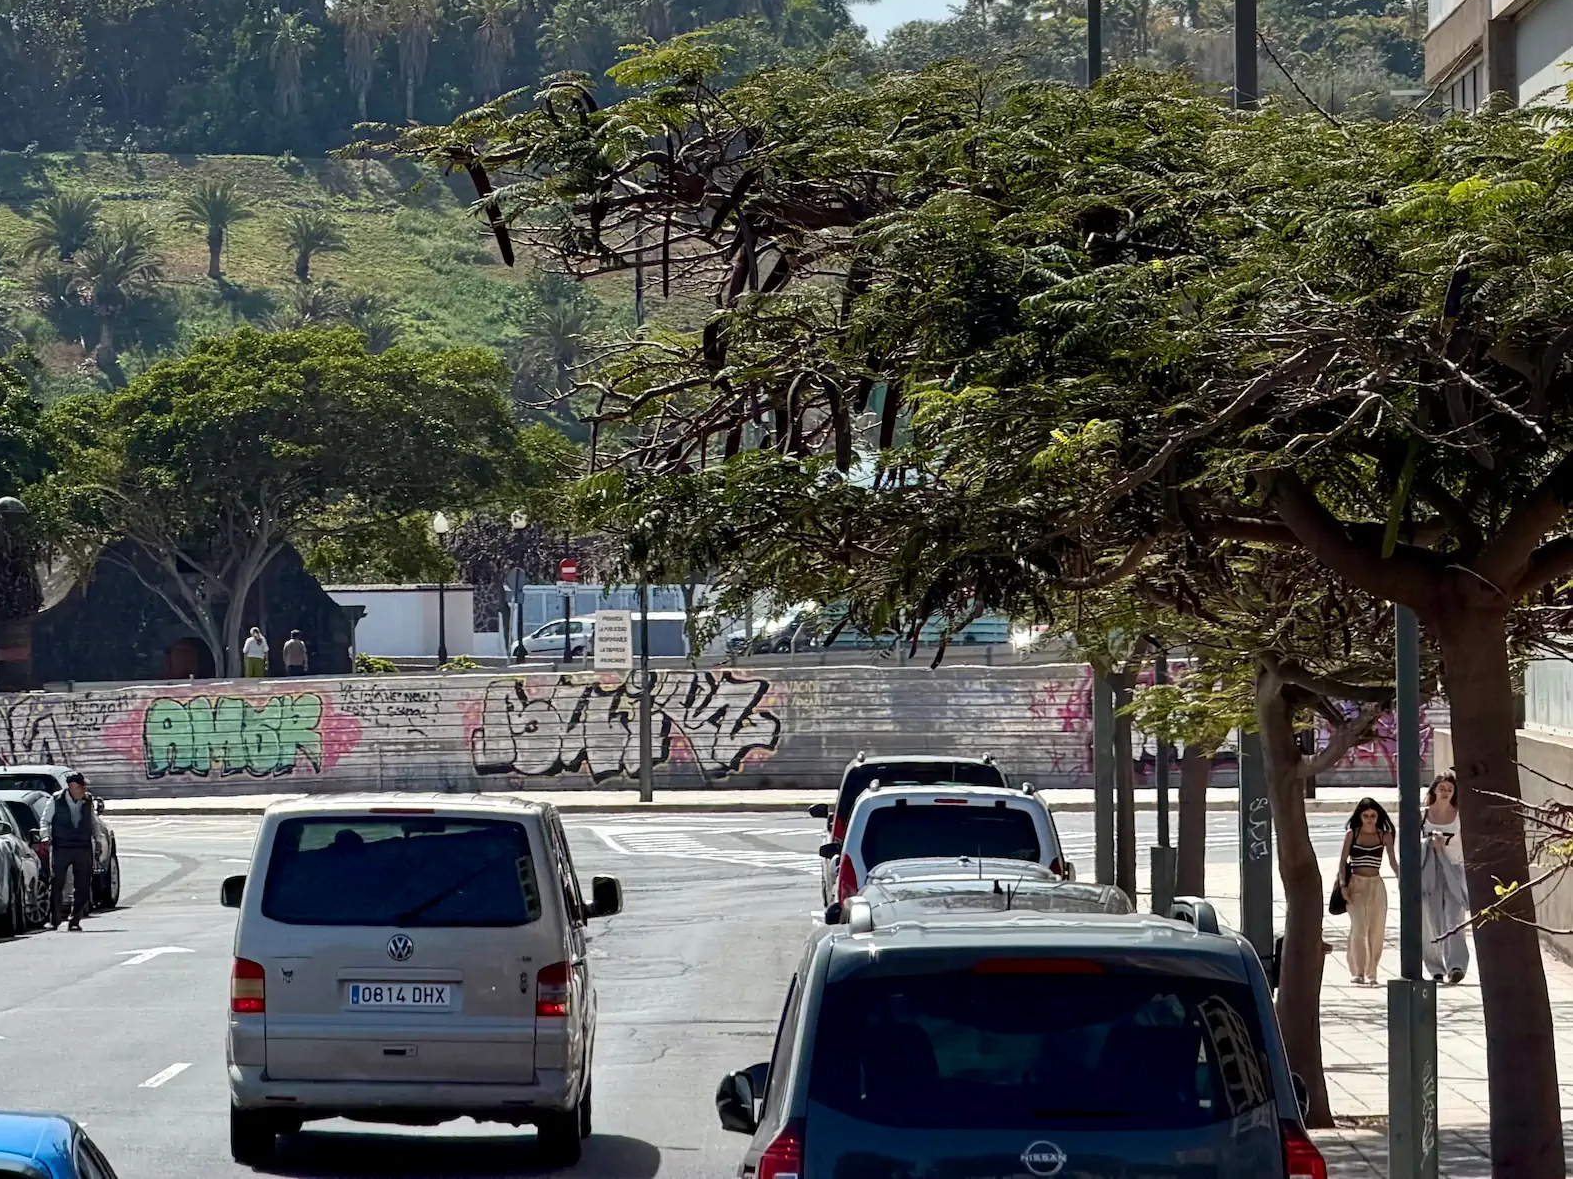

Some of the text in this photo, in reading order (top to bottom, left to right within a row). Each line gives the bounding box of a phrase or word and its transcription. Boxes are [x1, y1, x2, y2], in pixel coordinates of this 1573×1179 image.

[362, 986, 445, 1003] 0814 DHX
[1020, 1153, 1067, 1163] NISSAN
